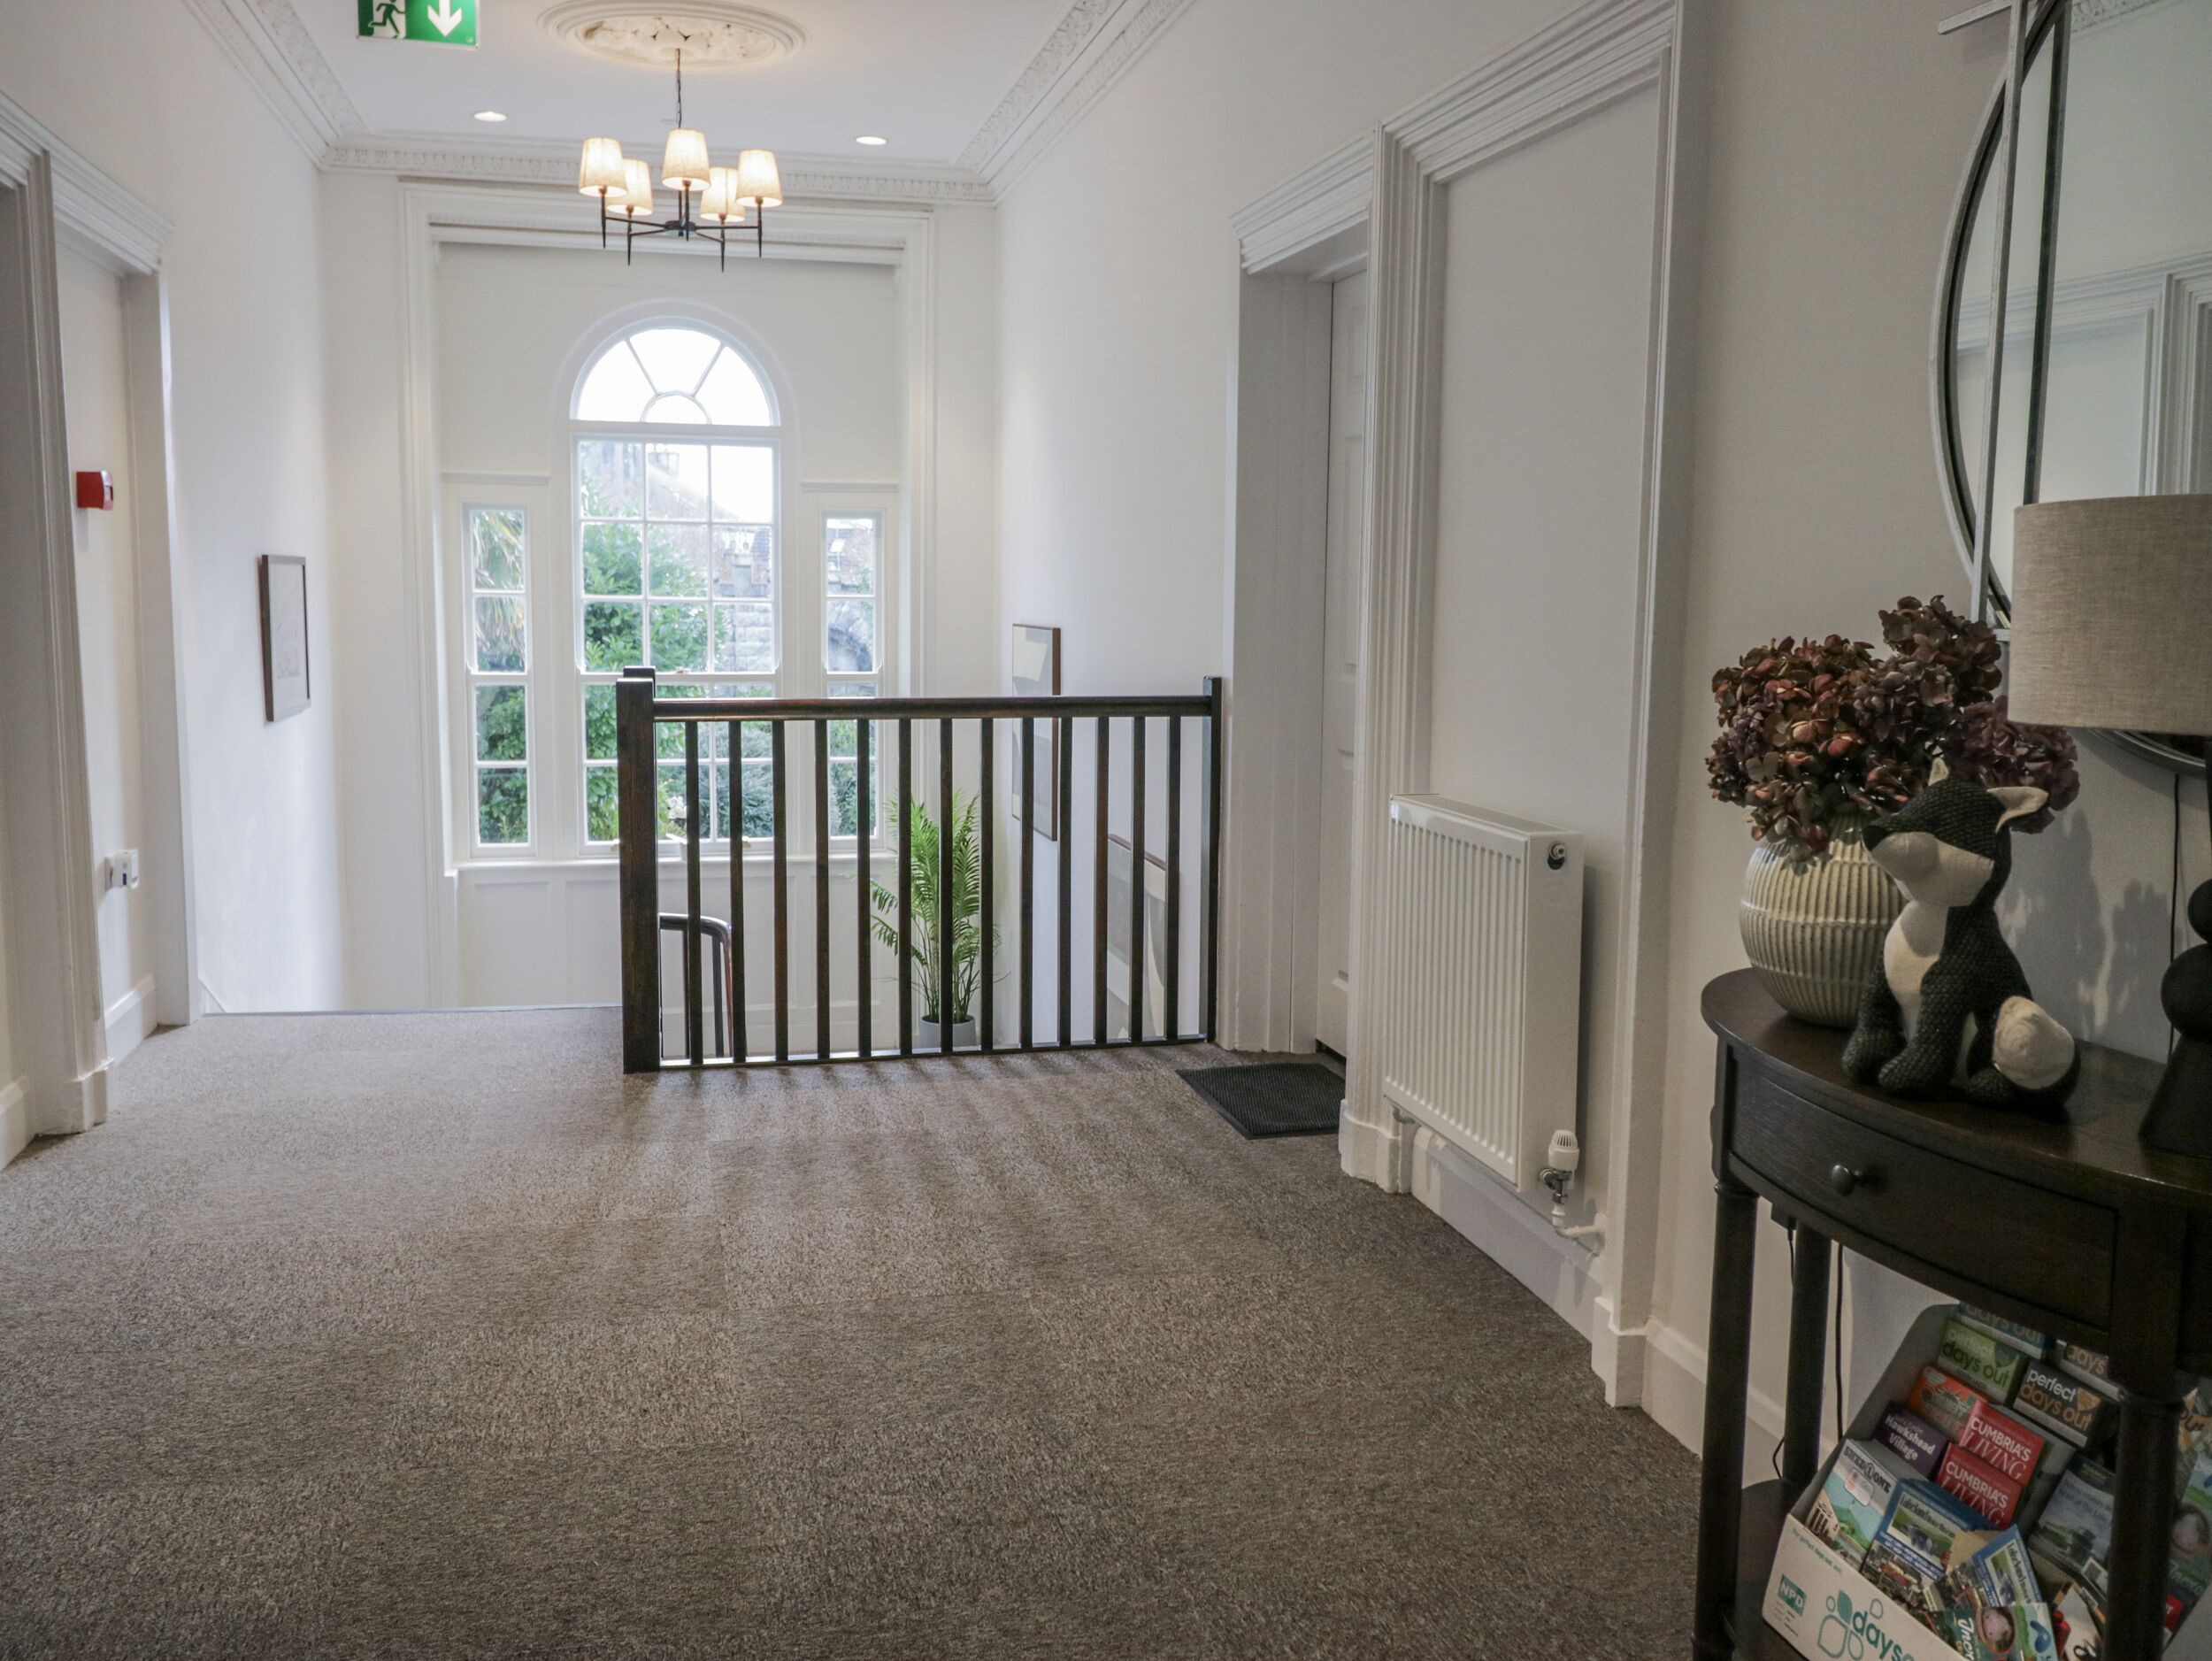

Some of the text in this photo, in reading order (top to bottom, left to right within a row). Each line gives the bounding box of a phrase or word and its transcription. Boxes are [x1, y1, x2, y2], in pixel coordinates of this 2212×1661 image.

[1942, 1342, 1981, 1372] days
[1983, 1364, 2011, 1388] out
[2066, 1344, 2108, 1375] days
[2026, 1368, 2077, 1403] perfect
[2021, 1382, 2093, 1431] days out
[1885, 1414, 1936, 1455] Hawkshead
[1889, 1433, 1918, 1461] Village
[1962, 1430, 2026, 1480] LIVING
[1970, 1417, 2032, 1462] CUMBRIA'S
[1873, 1472, 1892, 1494] ONE
[1946, 1461, 2008, 1509] CUMBRIA'S
[1780, 1582, 1804, 1607] NPD
